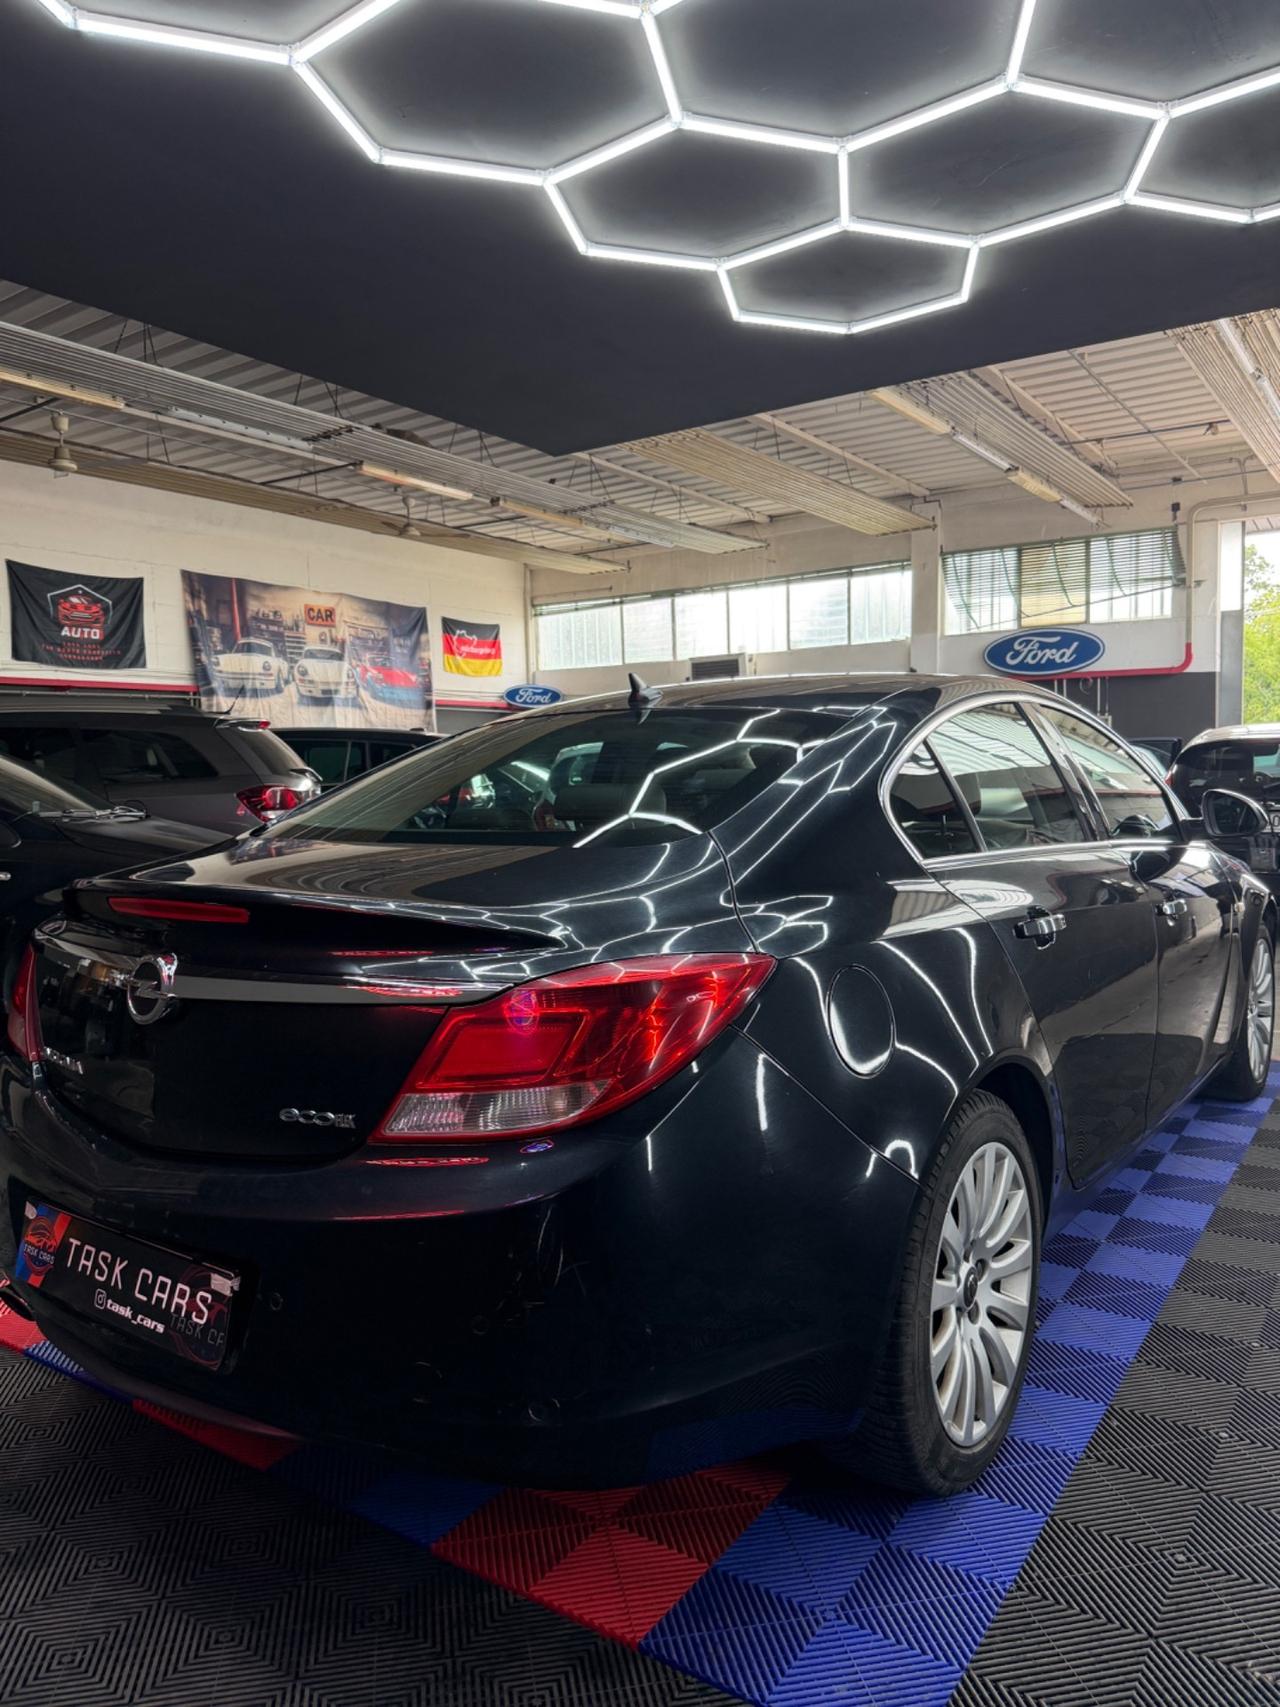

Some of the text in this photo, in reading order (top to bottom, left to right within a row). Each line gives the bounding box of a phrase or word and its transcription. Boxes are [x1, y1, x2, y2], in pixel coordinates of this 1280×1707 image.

[307, 607, 335, 623] CAR
[61, 626, 101, 640] AUTO
[1005, 636, 1079, 666] Ford
[515, 687, 552, 704] Ford
[66, 1237, 213, 1325] TASK CARS
[106, 1298, 166, 1334] task_cars
[170, 1313, 204, 1340] TASK
